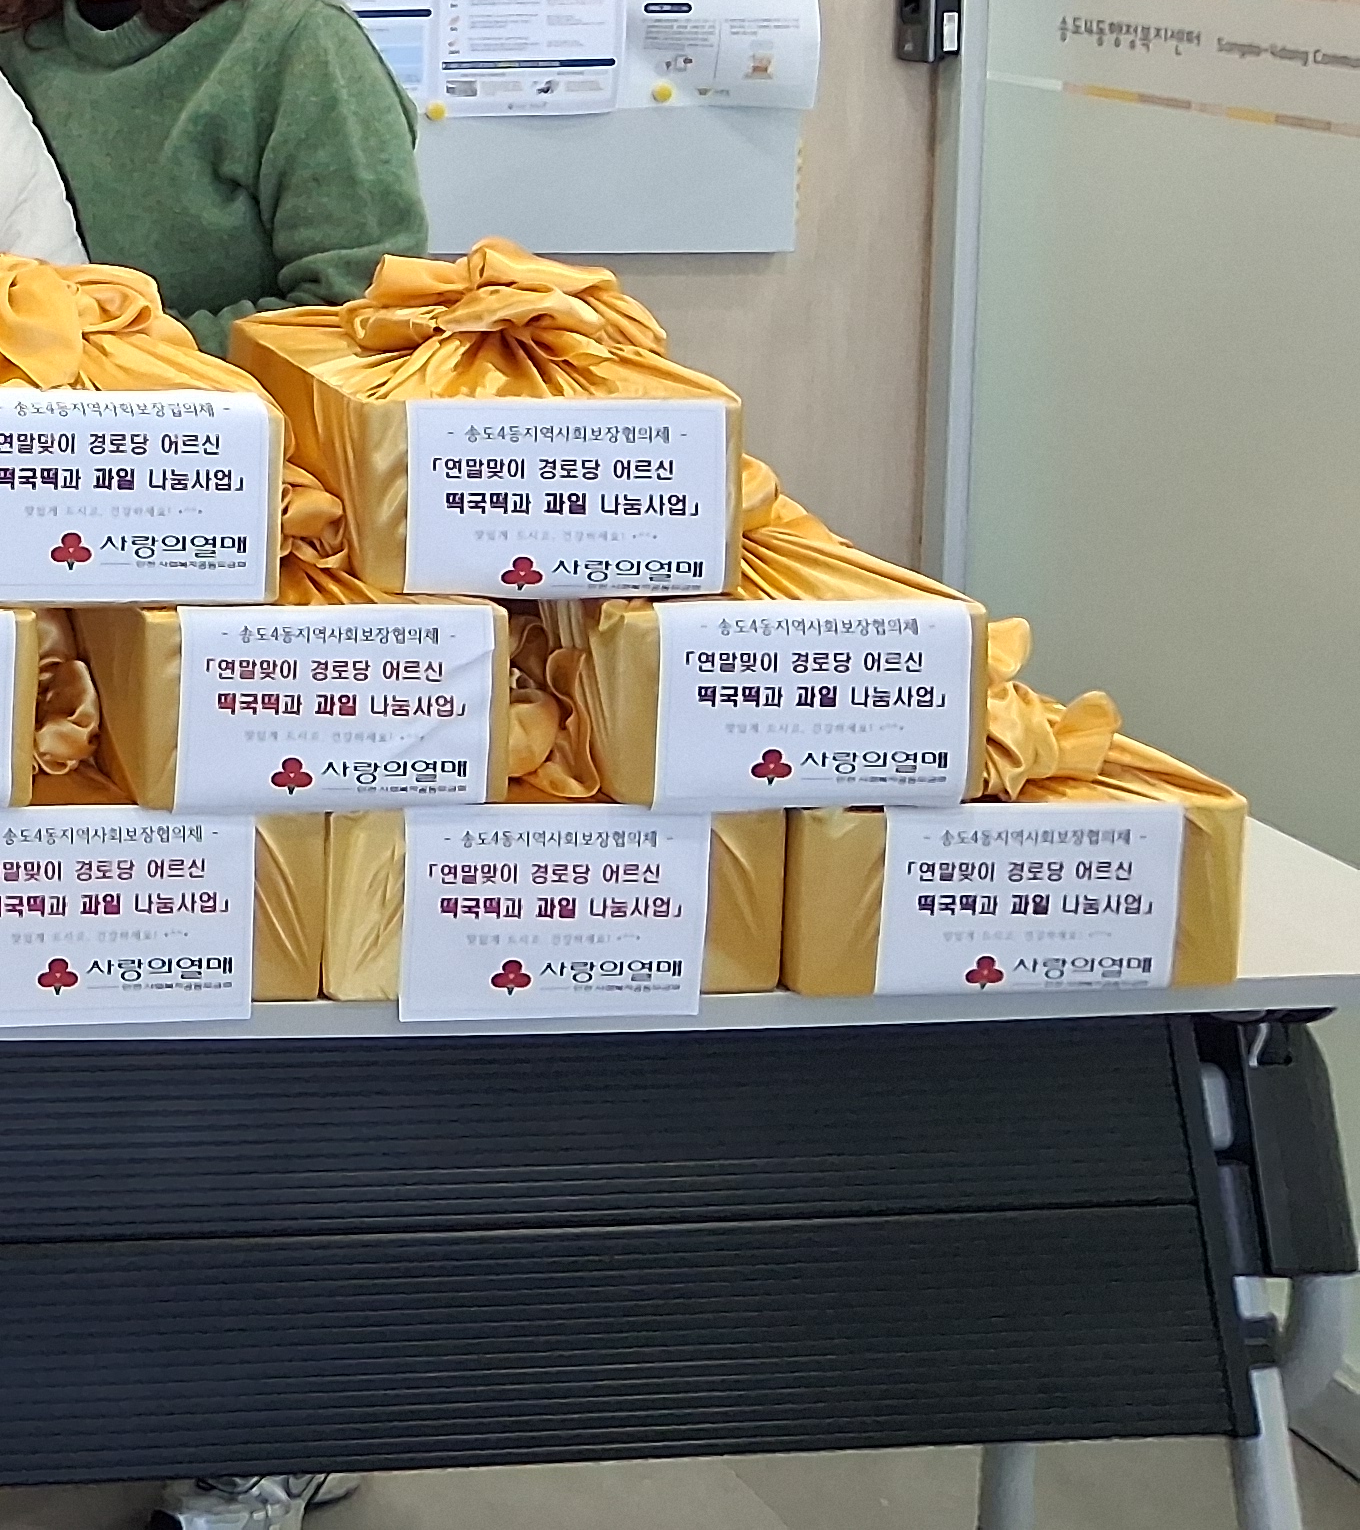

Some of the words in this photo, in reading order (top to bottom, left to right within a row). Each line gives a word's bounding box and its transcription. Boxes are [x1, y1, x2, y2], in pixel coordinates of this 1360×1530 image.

[539, 458, 600, 480] 경로당
[613, 458, 674, 480] 어르신
[445, 492, 530, 515] 떡국떡과
[544, 493, 586, 515] 과일
[601, 493, 700, 517] 나눔사업」
[552, 559, 704, 583] 사랑의열매
